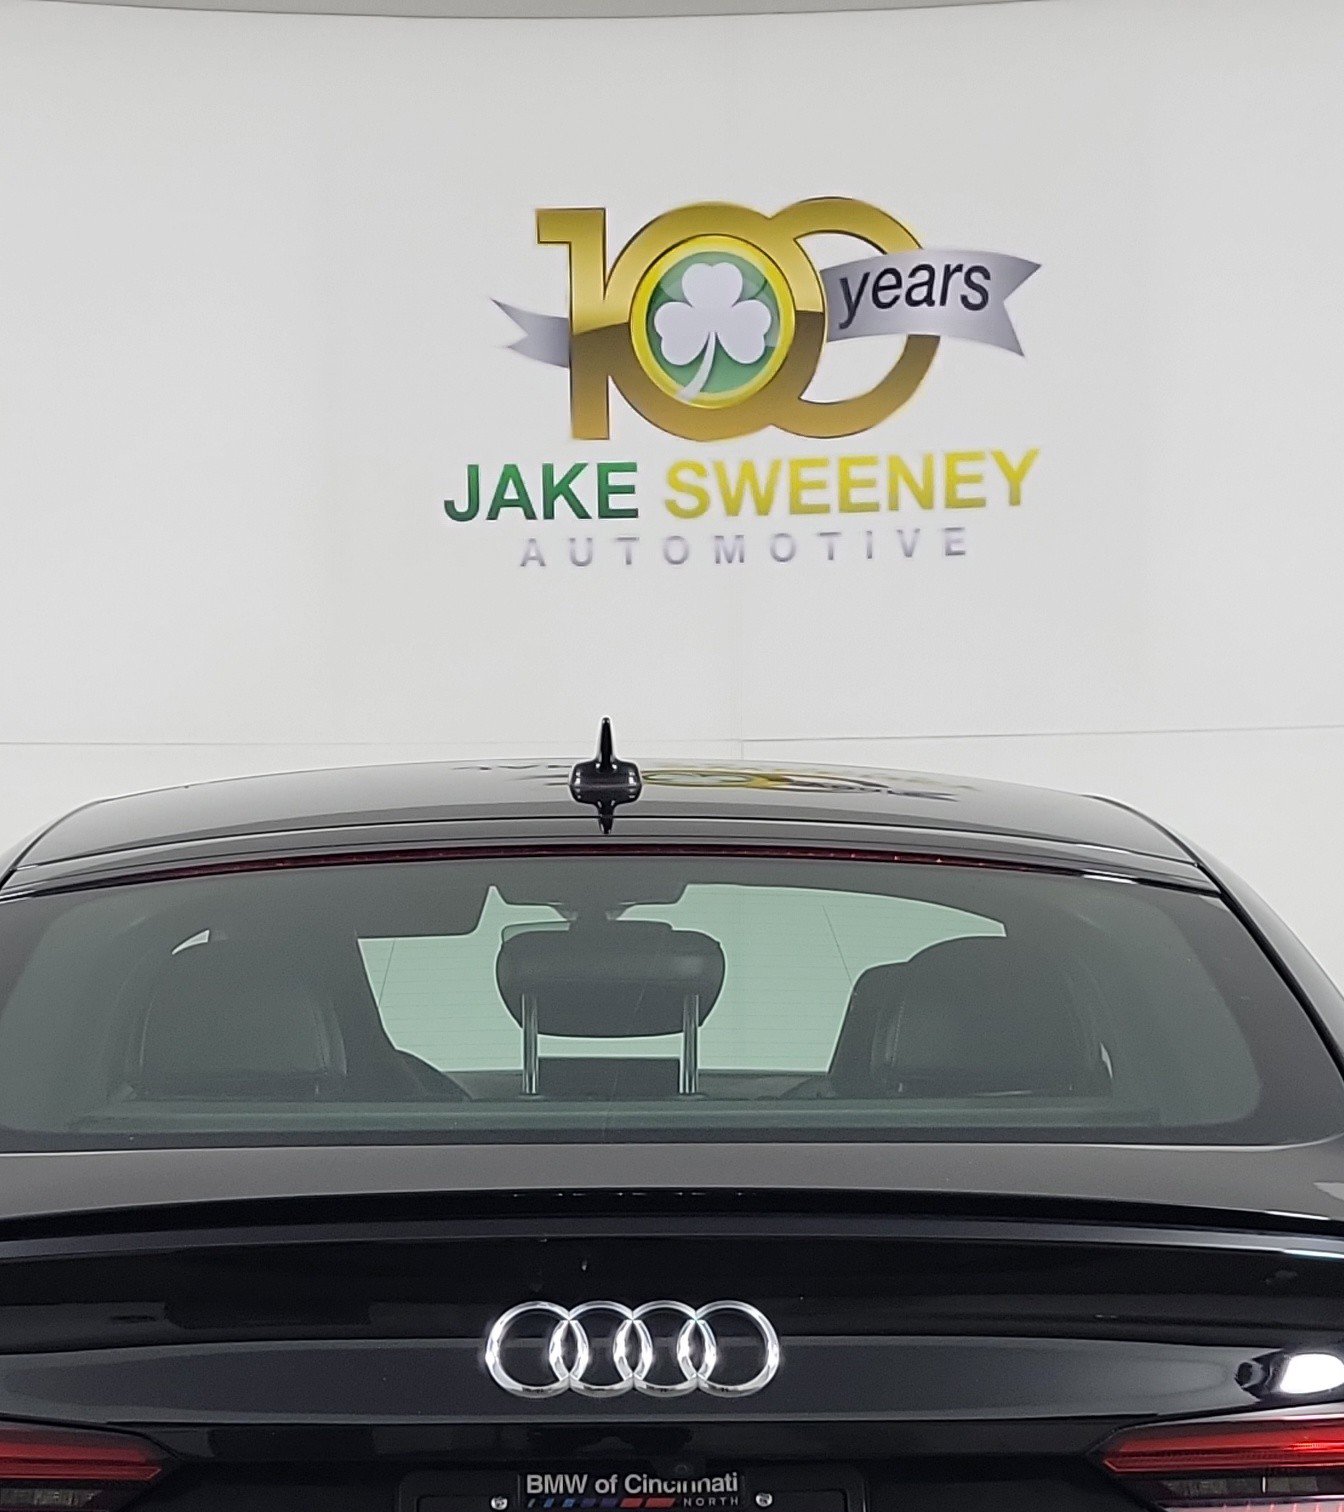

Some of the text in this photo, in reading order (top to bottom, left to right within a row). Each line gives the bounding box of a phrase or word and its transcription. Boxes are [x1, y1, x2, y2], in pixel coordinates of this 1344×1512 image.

[535, 196, 940, 442] 100
[838, 262, 992, 329] years
[443, 447, 1041, 522] JAKE SWEENEY
[519, 526, 966, 568] AUTOMOTIVE
[526, 1472, 738, 1494] BMW of Cincinnati
[683, 1496, 739, 1507] NORTH
